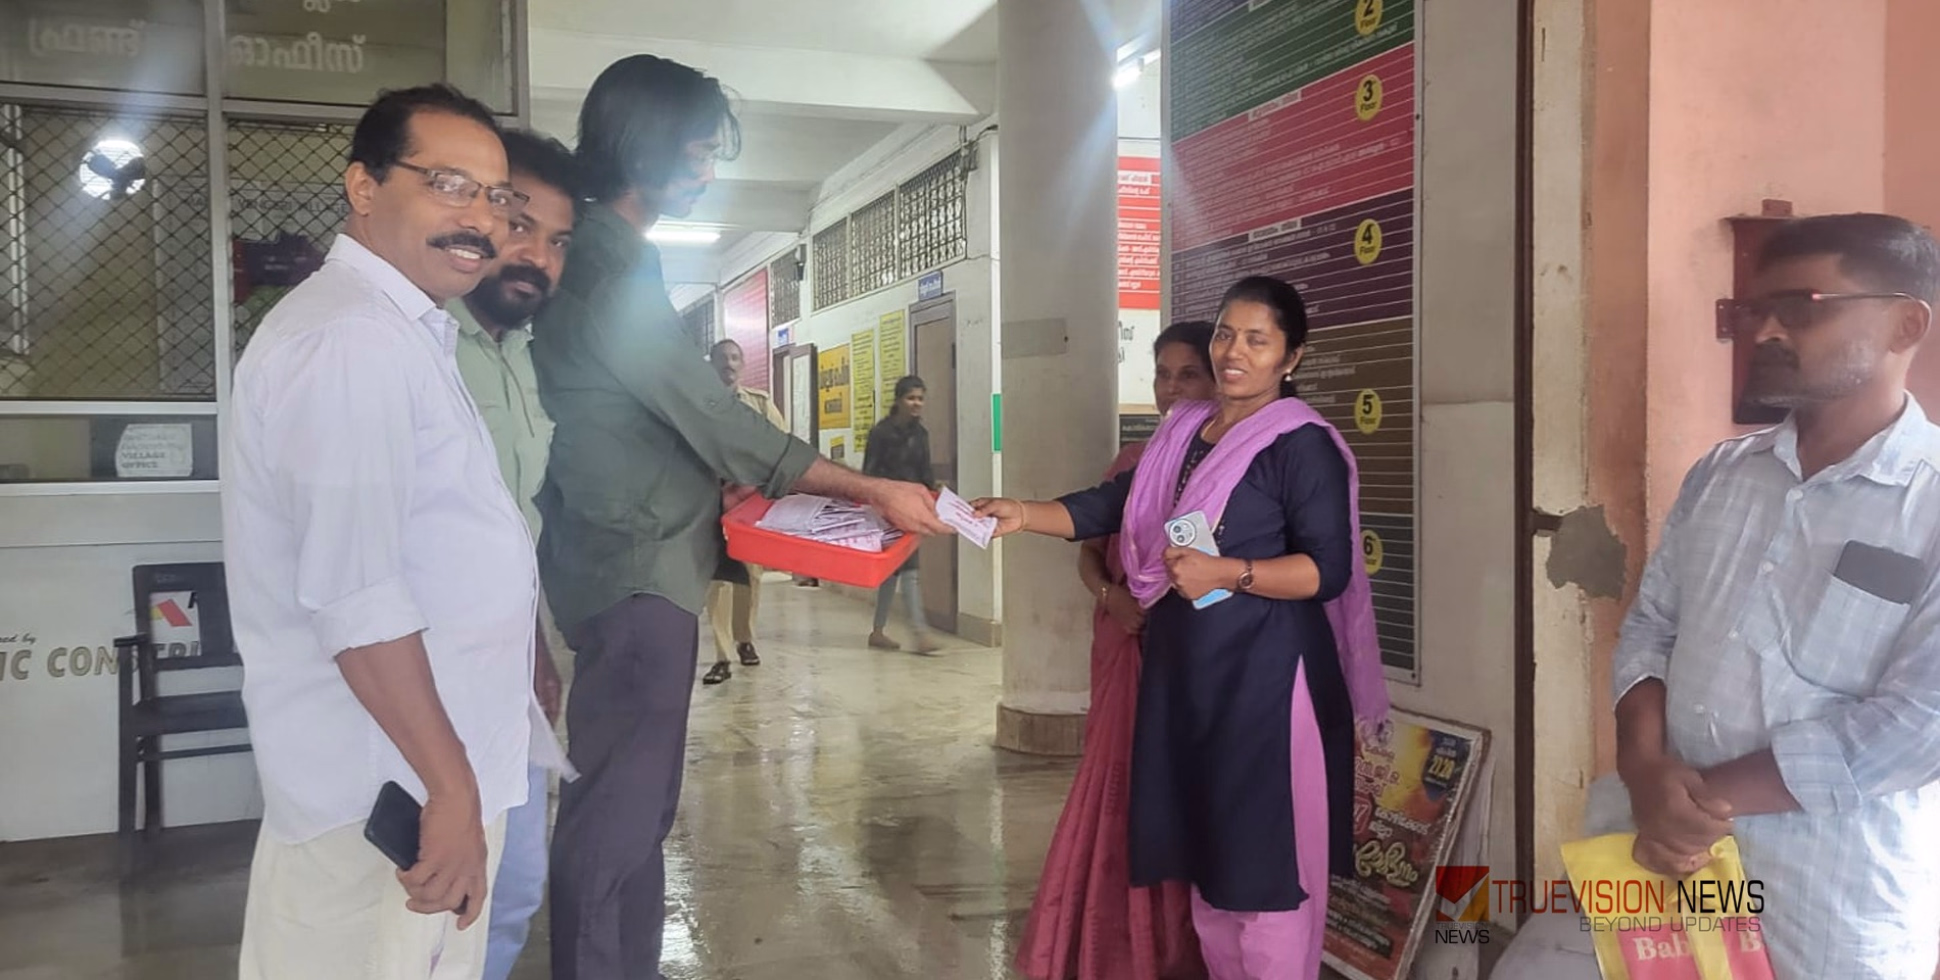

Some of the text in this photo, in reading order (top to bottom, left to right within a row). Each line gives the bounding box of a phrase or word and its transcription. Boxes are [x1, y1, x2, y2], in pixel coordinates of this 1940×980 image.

[1363, 0, 1374, 18] 2
[228, 32, 367, 73] ഓഫീസ്
[1363, 80, 1373, 102] 3
[1359, 102, 1378, 114] Floor
[1362, 223, 1374, 245] 4
[1359, 245, 1377, 256] Floor
[1362, 394, 1373, 415] 5
[1363, 535, 1374, 556] 6
